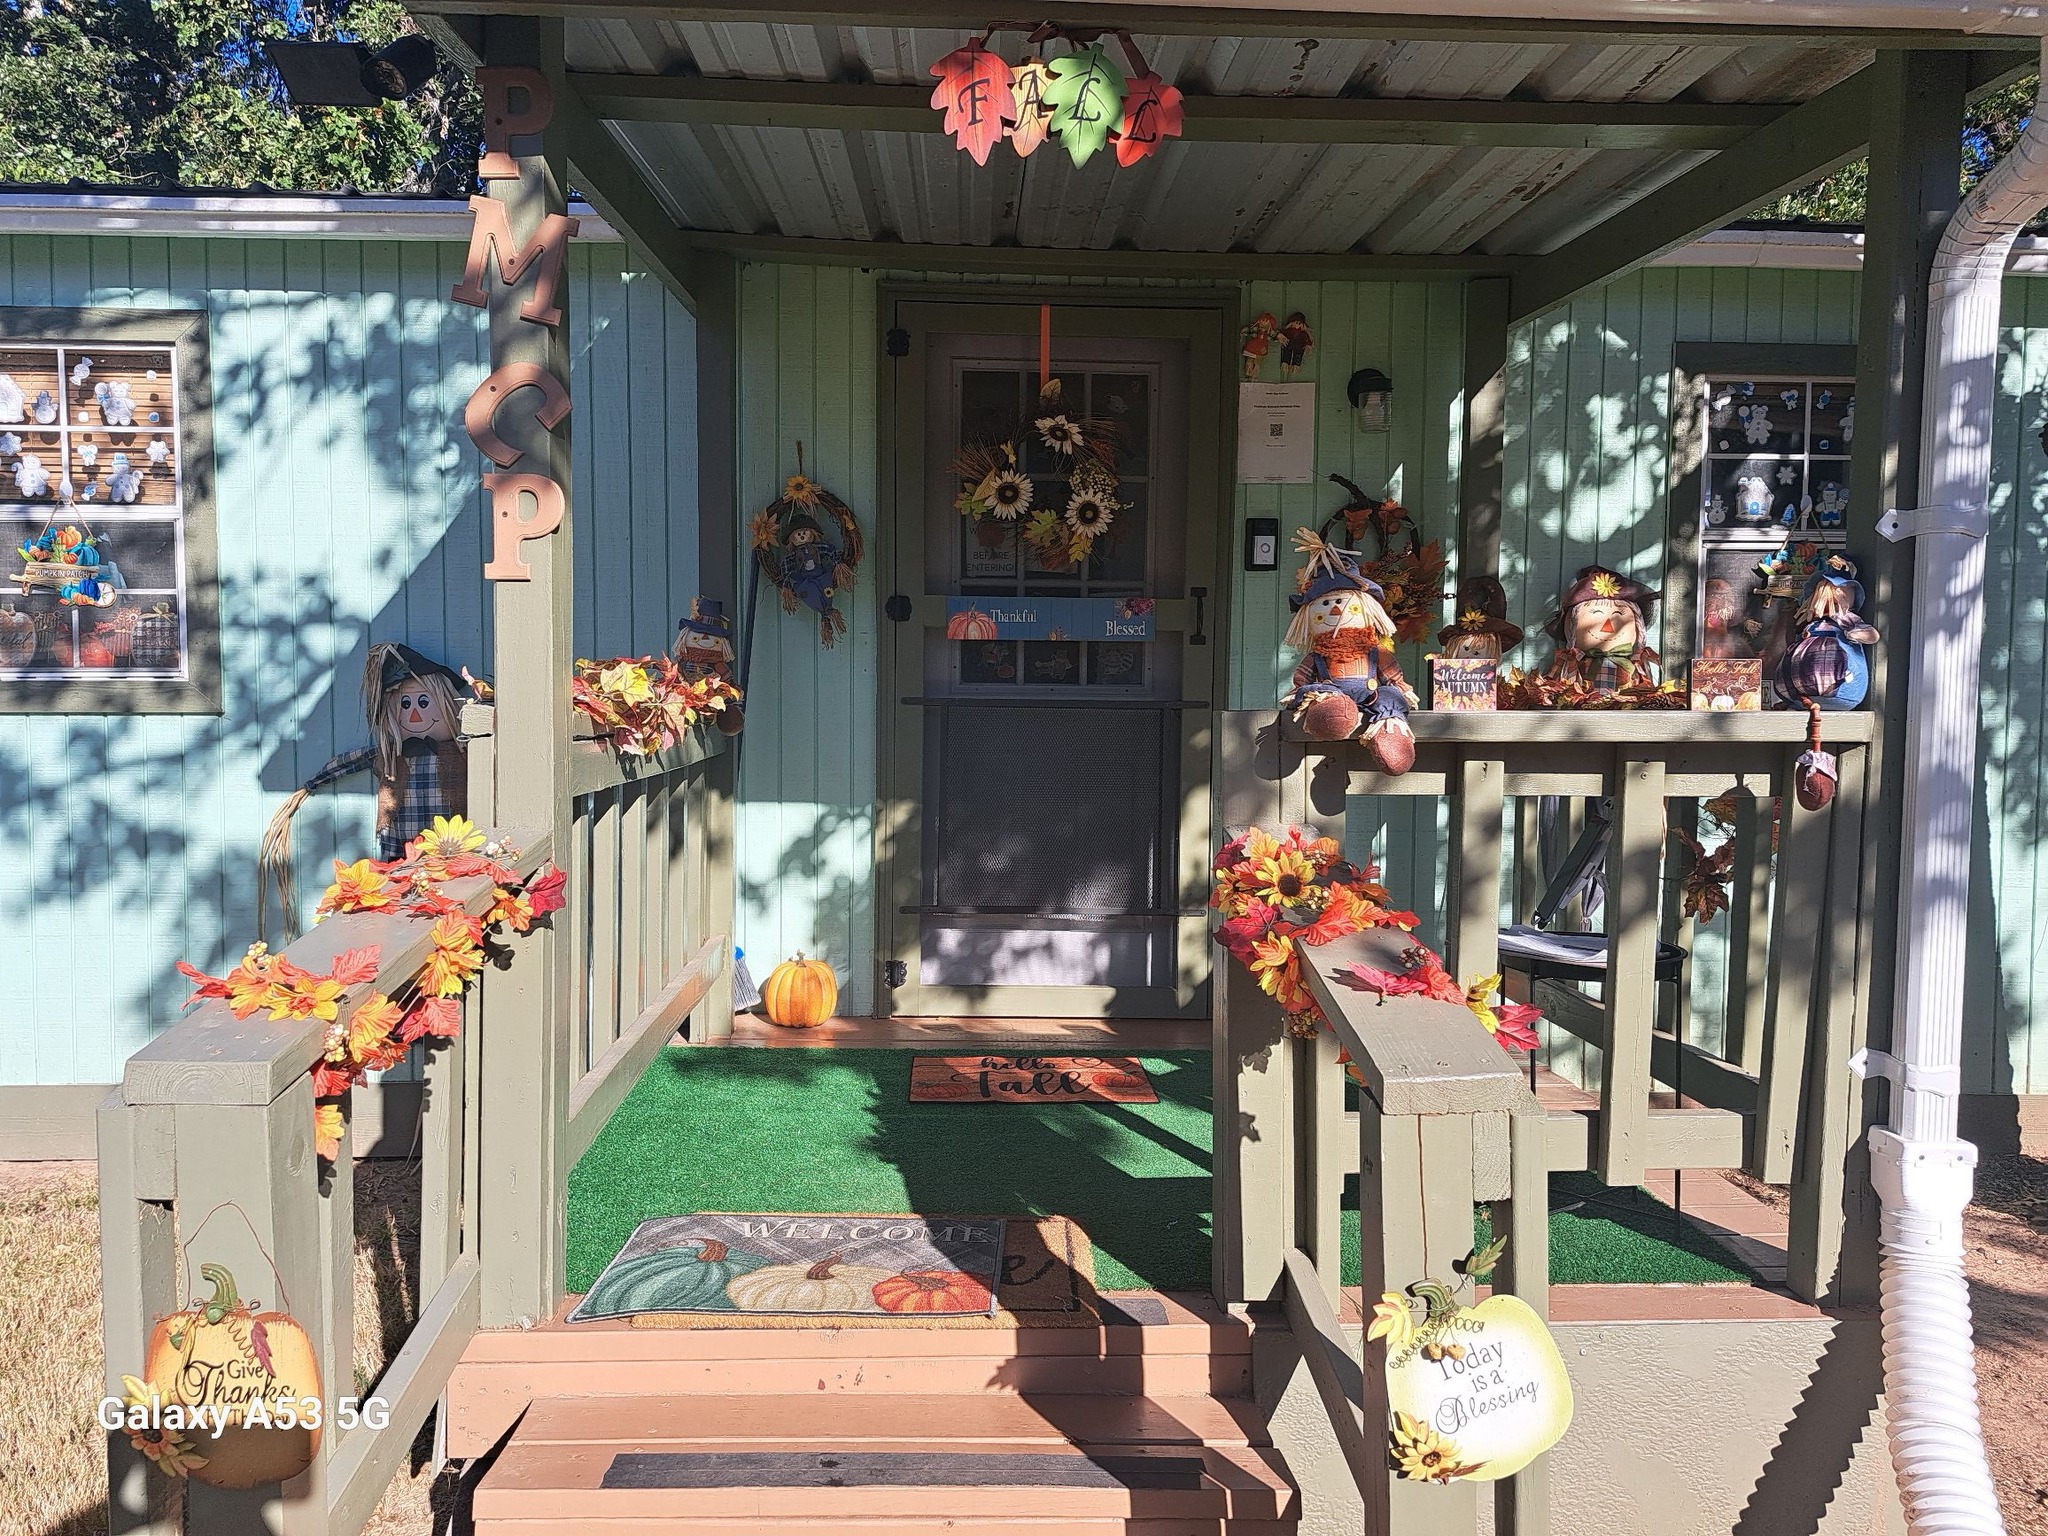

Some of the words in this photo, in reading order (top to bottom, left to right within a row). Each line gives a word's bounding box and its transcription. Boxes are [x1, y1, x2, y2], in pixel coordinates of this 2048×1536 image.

[958, 69, 1159, 143] FALL
[973, 551, 1009, 560] BEFRE
[35, 569, 65, 578] PUMPKIN
[66, 569, 90, 579] PATCH
[989, 609, 1037, 623] Thankful
[1105, 620, 1146, 636] Blessed
[1440, 668, 1487, 681] Welcome
[1694, 660, 1728, 673] Hello
[1730, 661, 1758, 674] Fall
[1440, 681, 1488, 693] AUTUMN
[981, 1057, 1055, 1071] hello
[742, 1221, 994, 1244] WELCOME
[1440, 1340, 1503, 1380] Today
[227, 1359, 264, 1379] Give
[1468, 1372, 1488, 1393] is
[1490, 1369, 1504, 1384] a
[1435, 1381, 1539, 1434] Blessing
